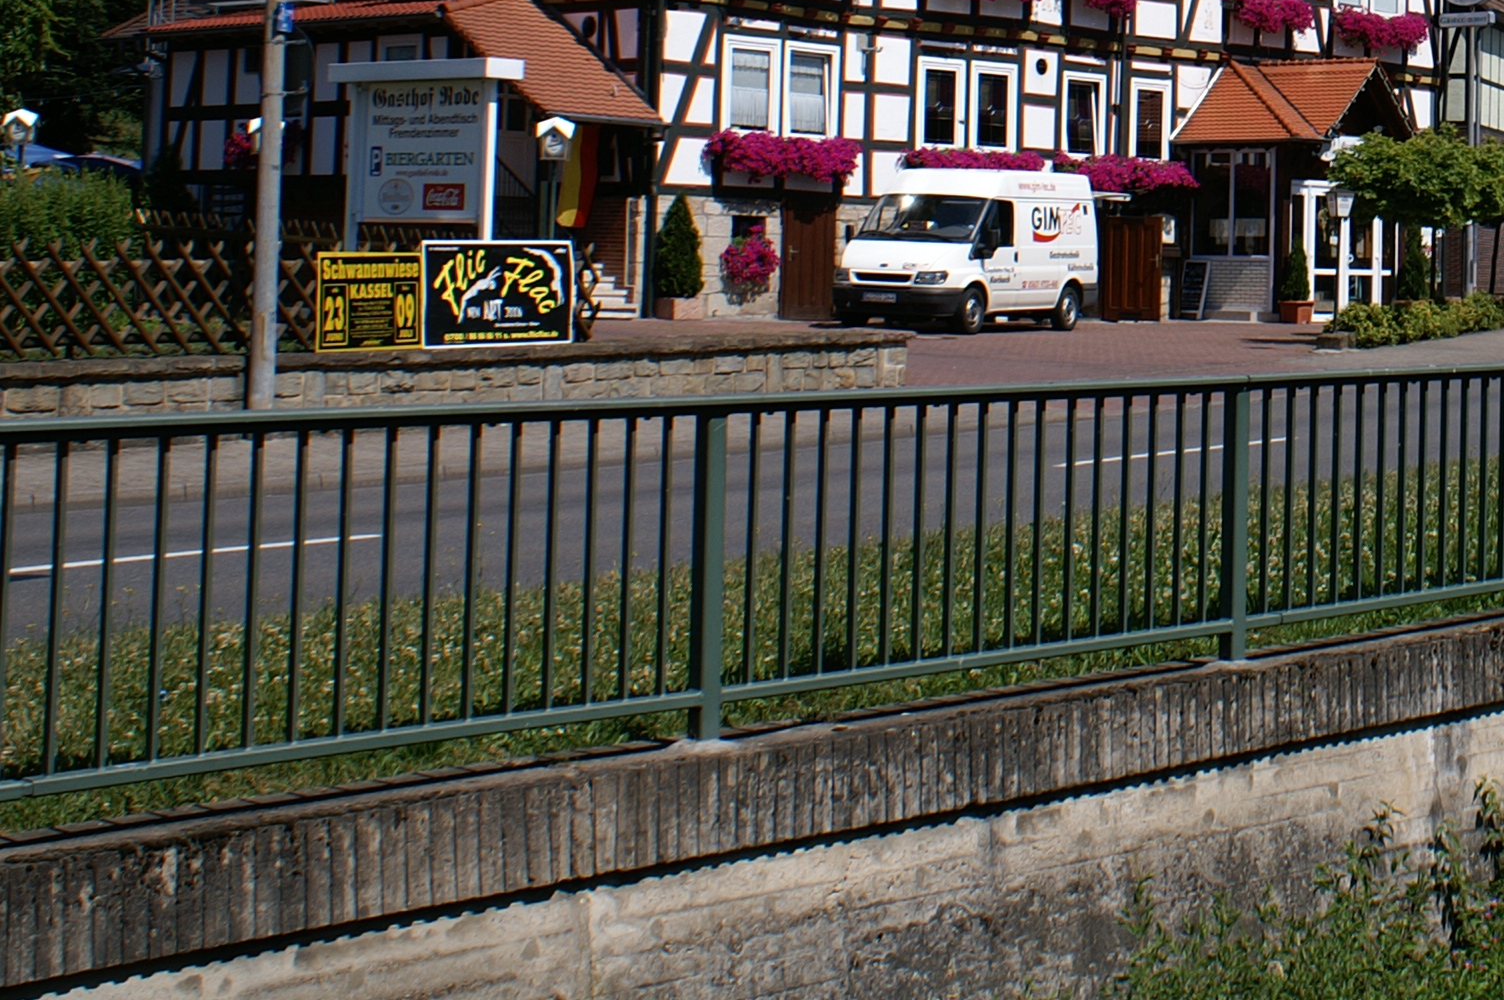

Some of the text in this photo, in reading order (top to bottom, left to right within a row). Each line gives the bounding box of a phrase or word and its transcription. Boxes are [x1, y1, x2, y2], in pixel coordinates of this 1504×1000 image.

[373, 85, 480, 112] Gasthof Rode
[409, 114, 426, 124] und
[388, 127, 460, 138] Fremdenzimmer
[385, 152, 474, 166] BIERGARTEN
[322, 258, 419, 280] Schwanenwiese
[349, 283, 394, 299] KASSEL
[433, 249, 486, 316] Flic
[500, 256, 556, 315] Flac
